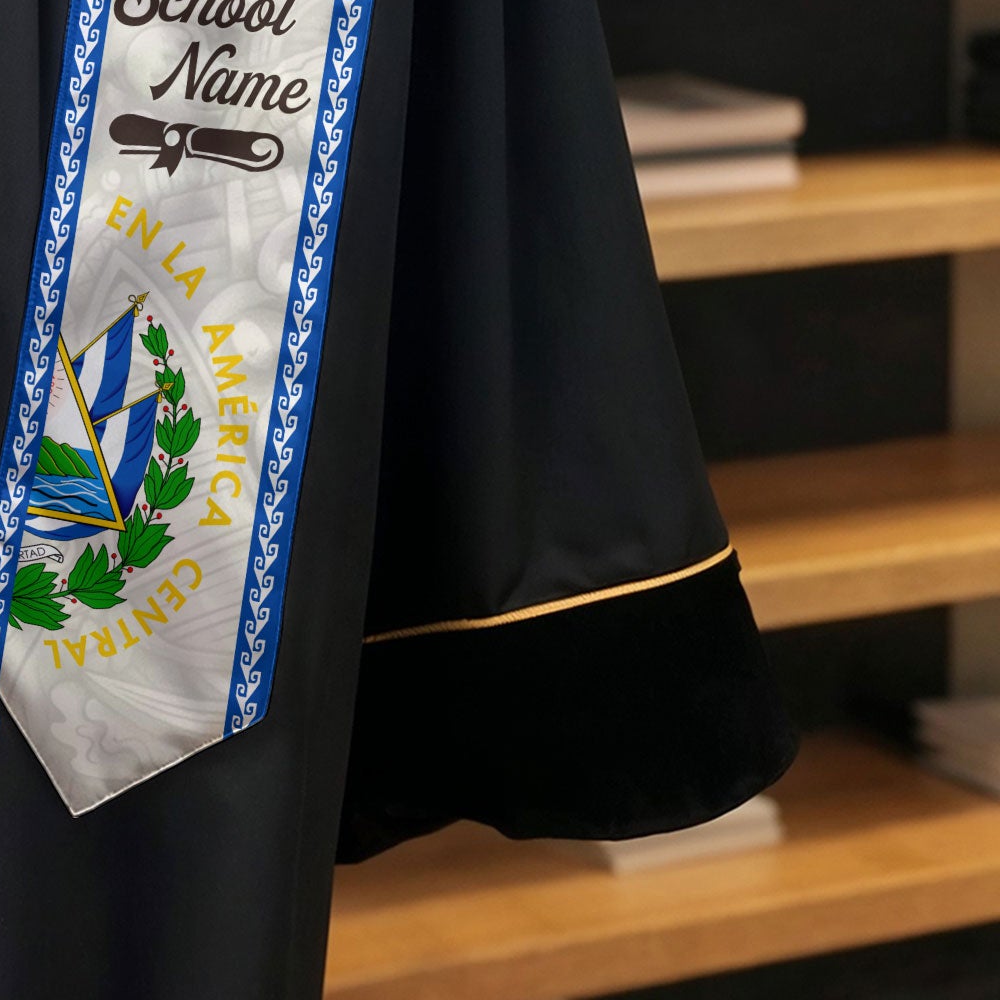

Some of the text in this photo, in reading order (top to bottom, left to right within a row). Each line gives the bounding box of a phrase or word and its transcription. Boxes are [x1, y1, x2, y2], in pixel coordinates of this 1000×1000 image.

[149, 41, 312, 115] Name
[44, 195, 258, 669] EN LA AMÉRICA CENTRAL
